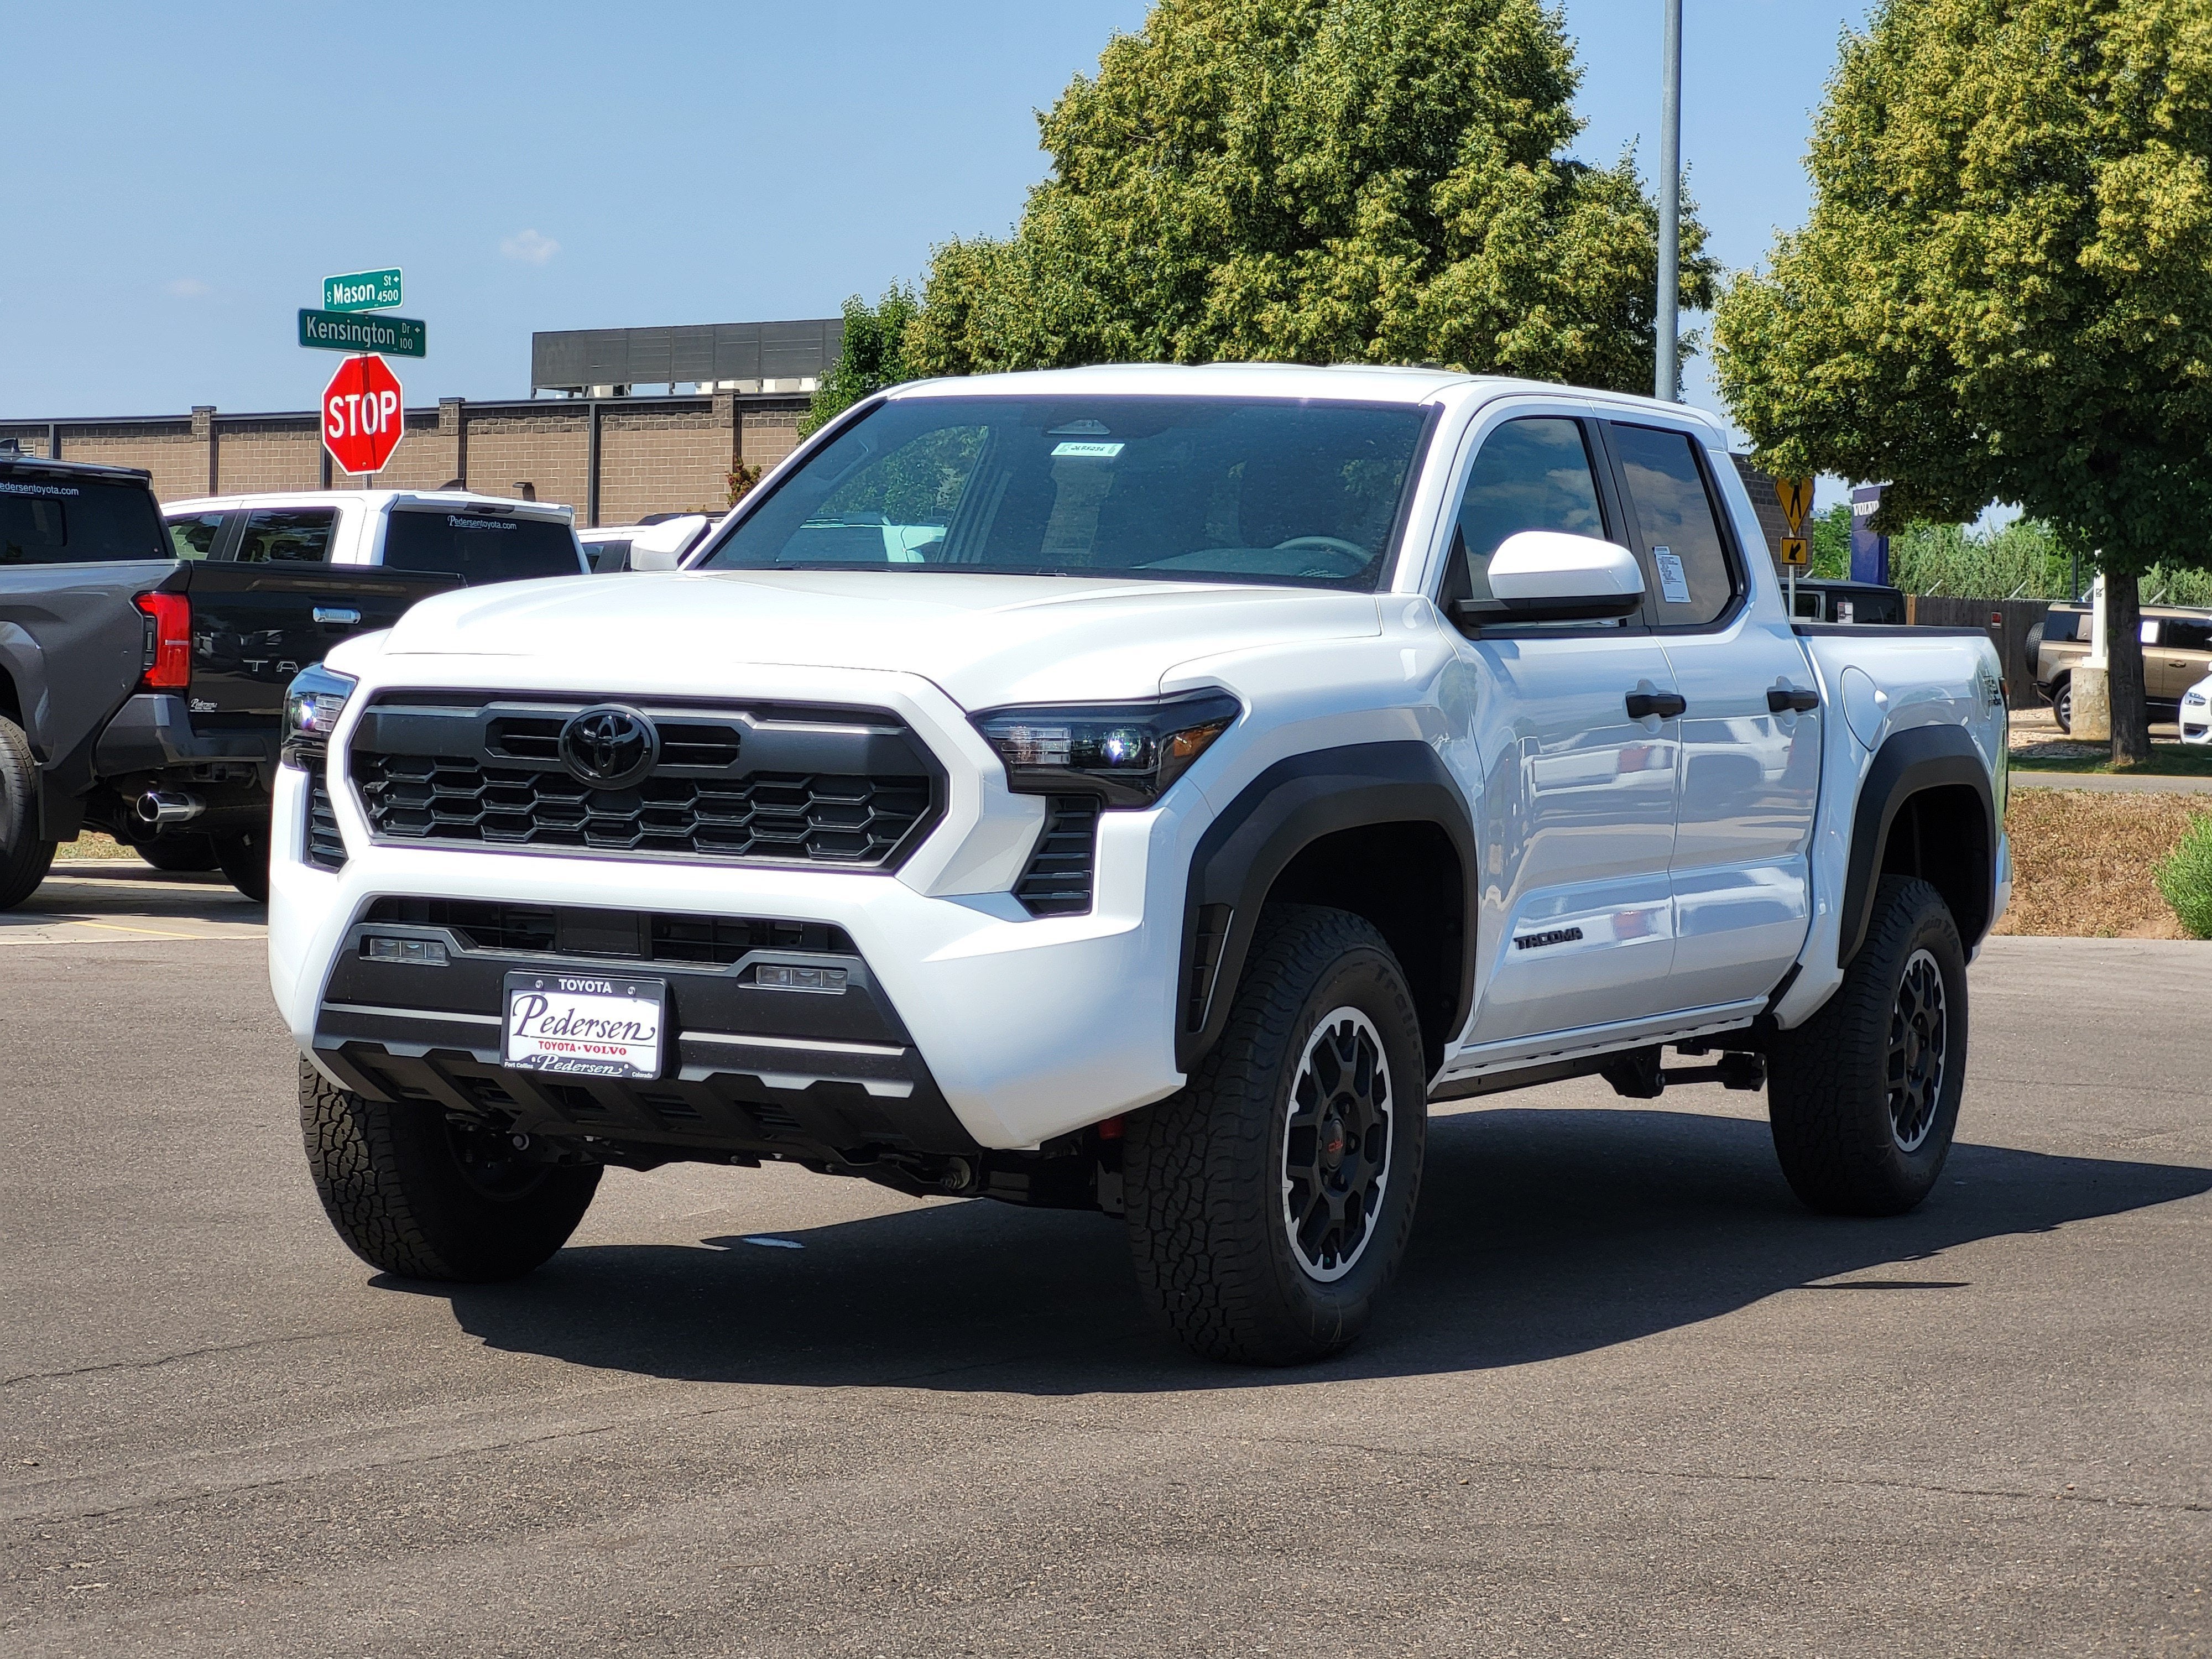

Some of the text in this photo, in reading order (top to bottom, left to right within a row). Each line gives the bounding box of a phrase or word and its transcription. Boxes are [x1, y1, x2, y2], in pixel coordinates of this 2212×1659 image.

[326, 275, 392, 305] S Mason St
[377, 289, 399, 302] 4500
[306, 316, 411, 348] Kensington Dr
[400, 337, 413, 349] 100
[328, 390, 397, 439] STOP
[0, 482, 79, 495] edersentoyota.com
[1853, 500, 1880, 517] VOLVO
[447, 515, 517, 530] Pedersentoyota.com
[243, 660, 322, 673] TA
[1514, 927, 1583, 950] TACOMA
[559, 978, 612, 994] TOYOTA
[512, 994, 656, 1041] Pedersen
[538, 1040, 627, 1055] TOYOTA VOLVO
[536, 1053, 623, 1075] Pedersen
